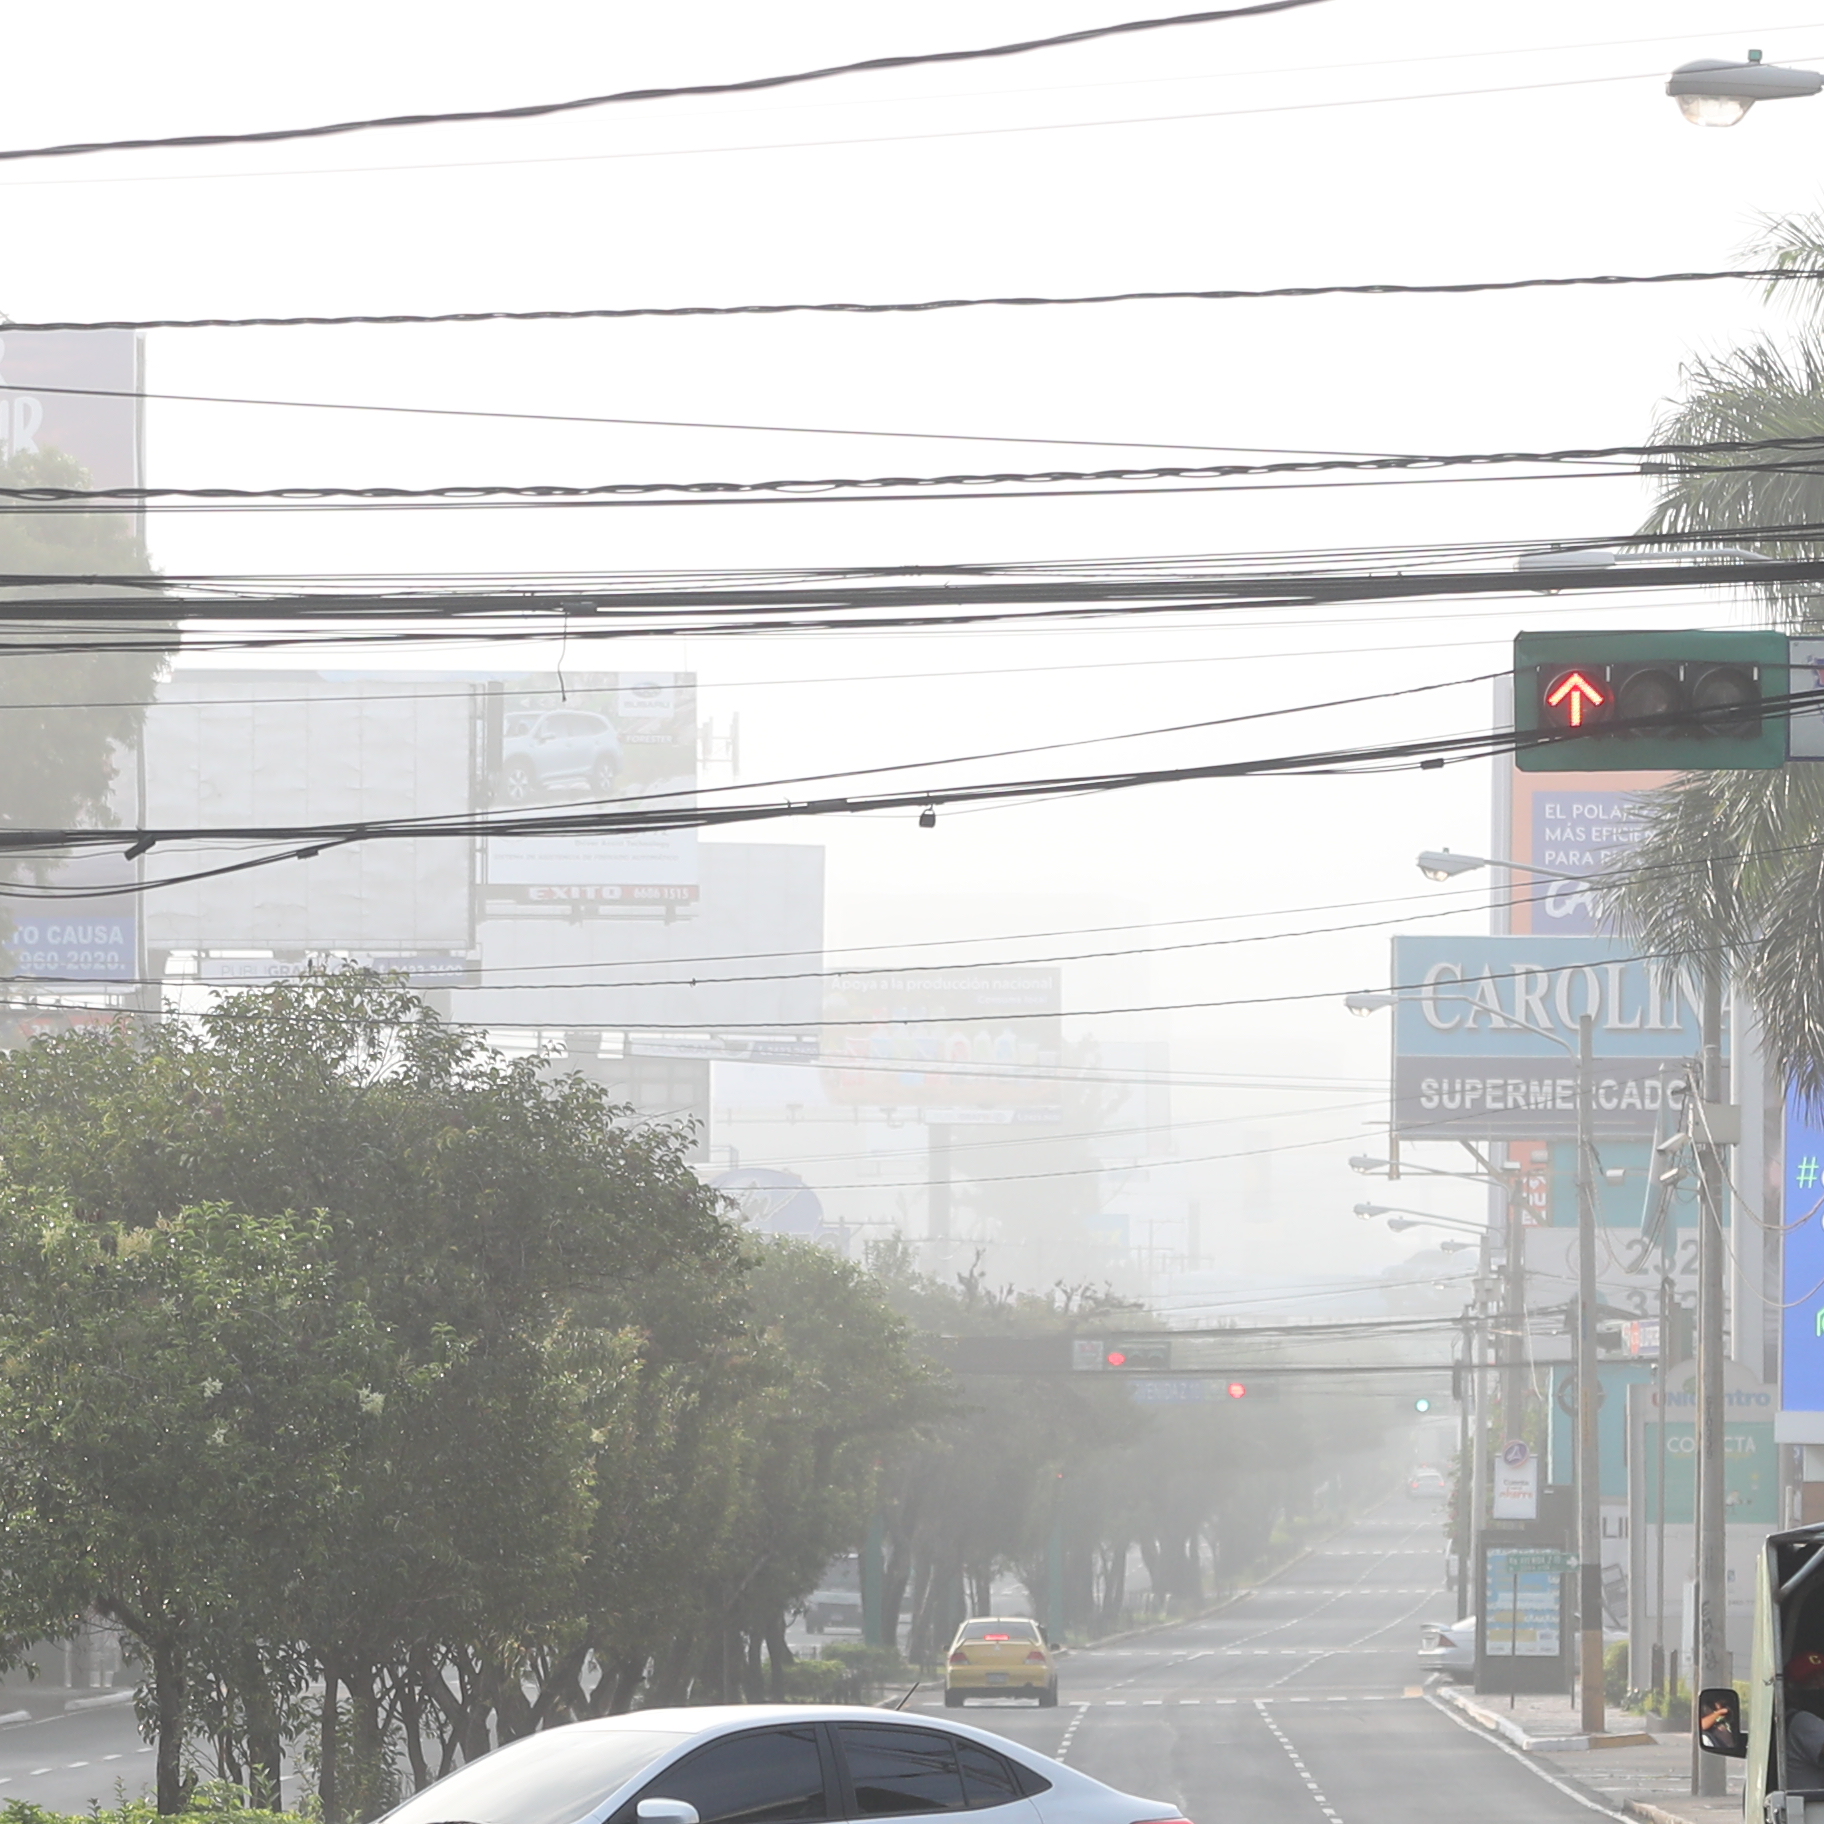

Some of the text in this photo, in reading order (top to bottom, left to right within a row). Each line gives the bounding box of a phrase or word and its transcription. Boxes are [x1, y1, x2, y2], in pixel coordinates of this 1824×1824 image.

[1544, 803, 1566, 820] EL
[1544, 822, 1586, 842] MÁS
[1544, 850, 1594, 866] PARA
[529, 886, 622, 900] EXITO
[43, 925, 124, 945] CAUSA
[831, 977, 877, 993] Apoya
[891, 977, 904, 990] la
[907, 976, 990, 992] producción
[992, 976, 1053, 990] nacional
[1422, 962, 1729, 1031] CAROLIN
[1420, 1078, 1686, 1111] SUPERMECADO
[1667, 1437, 1756, 1453] COCTA
